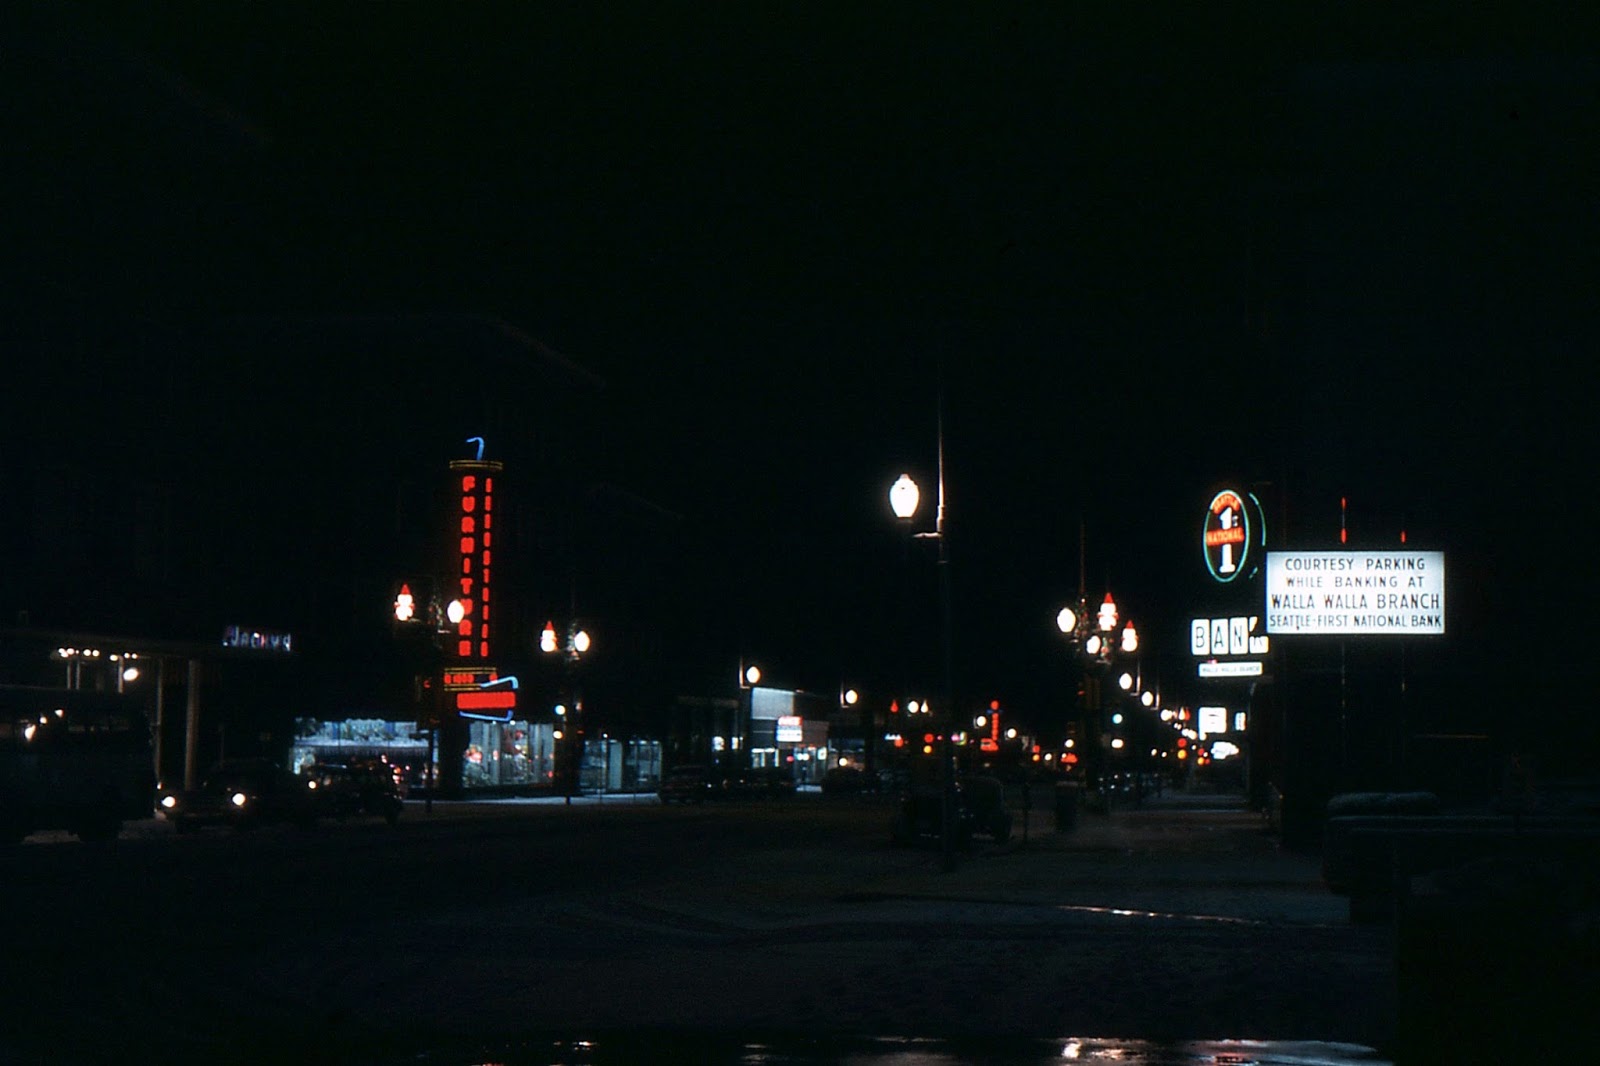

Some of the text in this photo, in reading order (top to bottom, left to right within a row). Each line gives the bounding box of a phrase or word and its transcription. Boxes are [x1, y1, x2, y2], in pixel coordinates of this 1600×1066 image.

[1285, 557, 1426, 571] COURTESY PARKING
[1286, 576, 1425, 588] WHILE BANKING AT
[1271, 593, 1440, 610] WALLA WALLA BRANCH
[1269, 614, 1442, 628] SEATTLE-FIRST NATIONAL BANK
